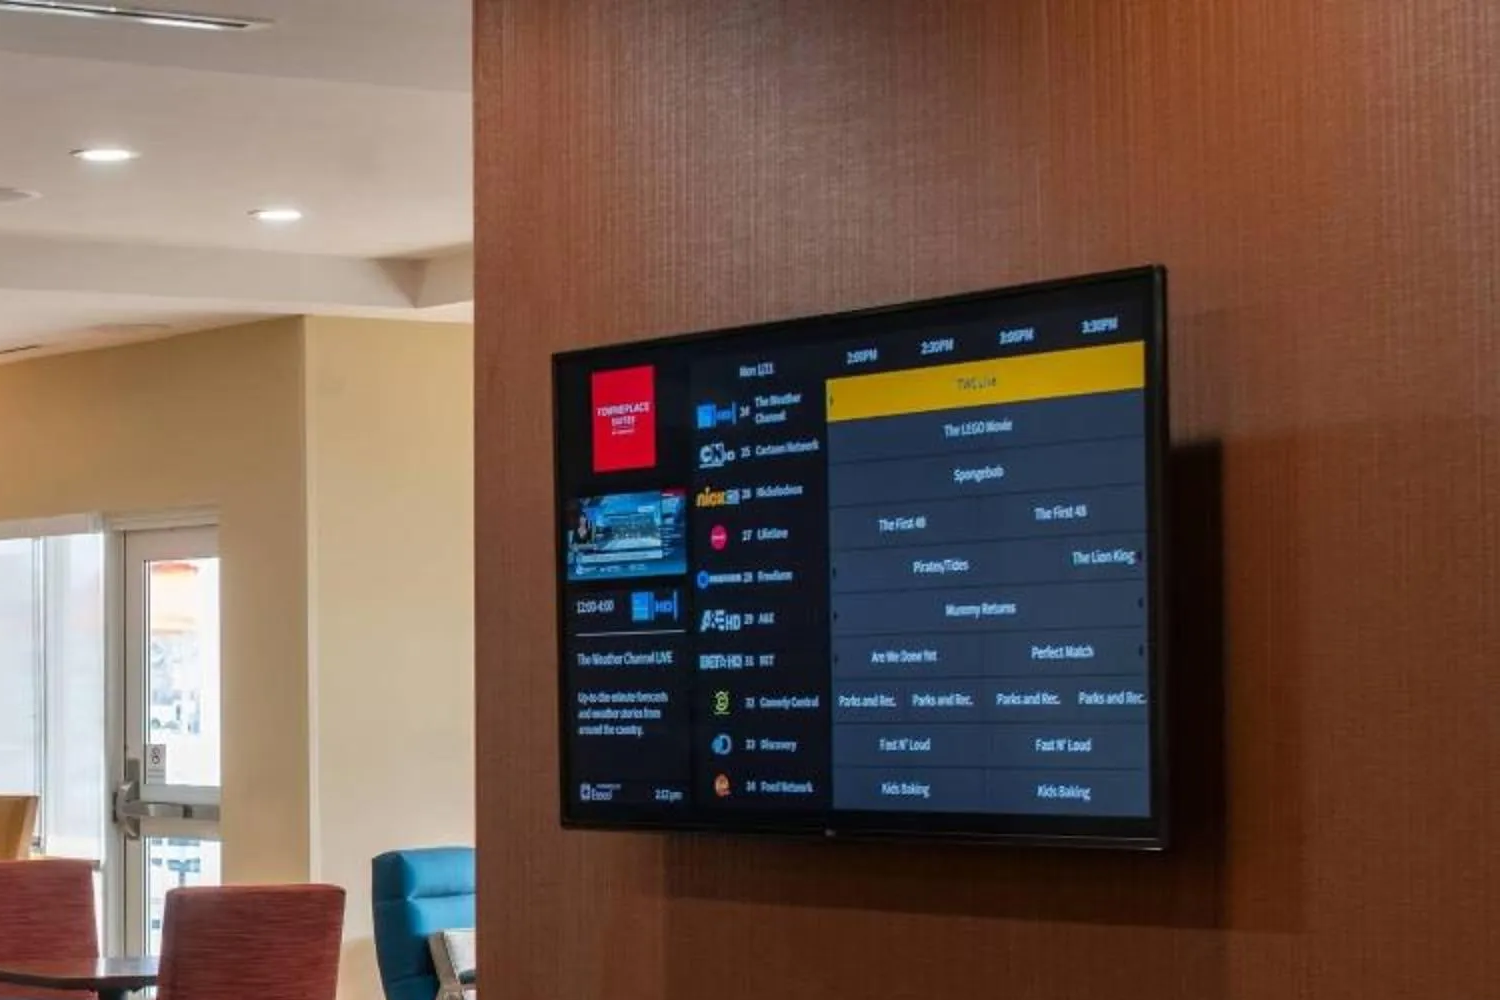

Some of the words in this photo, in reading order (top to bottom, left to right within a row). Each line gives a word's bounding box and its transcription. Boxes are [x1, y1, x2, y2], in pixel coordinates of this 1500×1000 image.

[1072, 552, 1090, 564] The
[1092, 551, 1112, 563] Lion
[1114, 549, 1135, 564] King
[1032, 647, 1064, 660] Perfect
